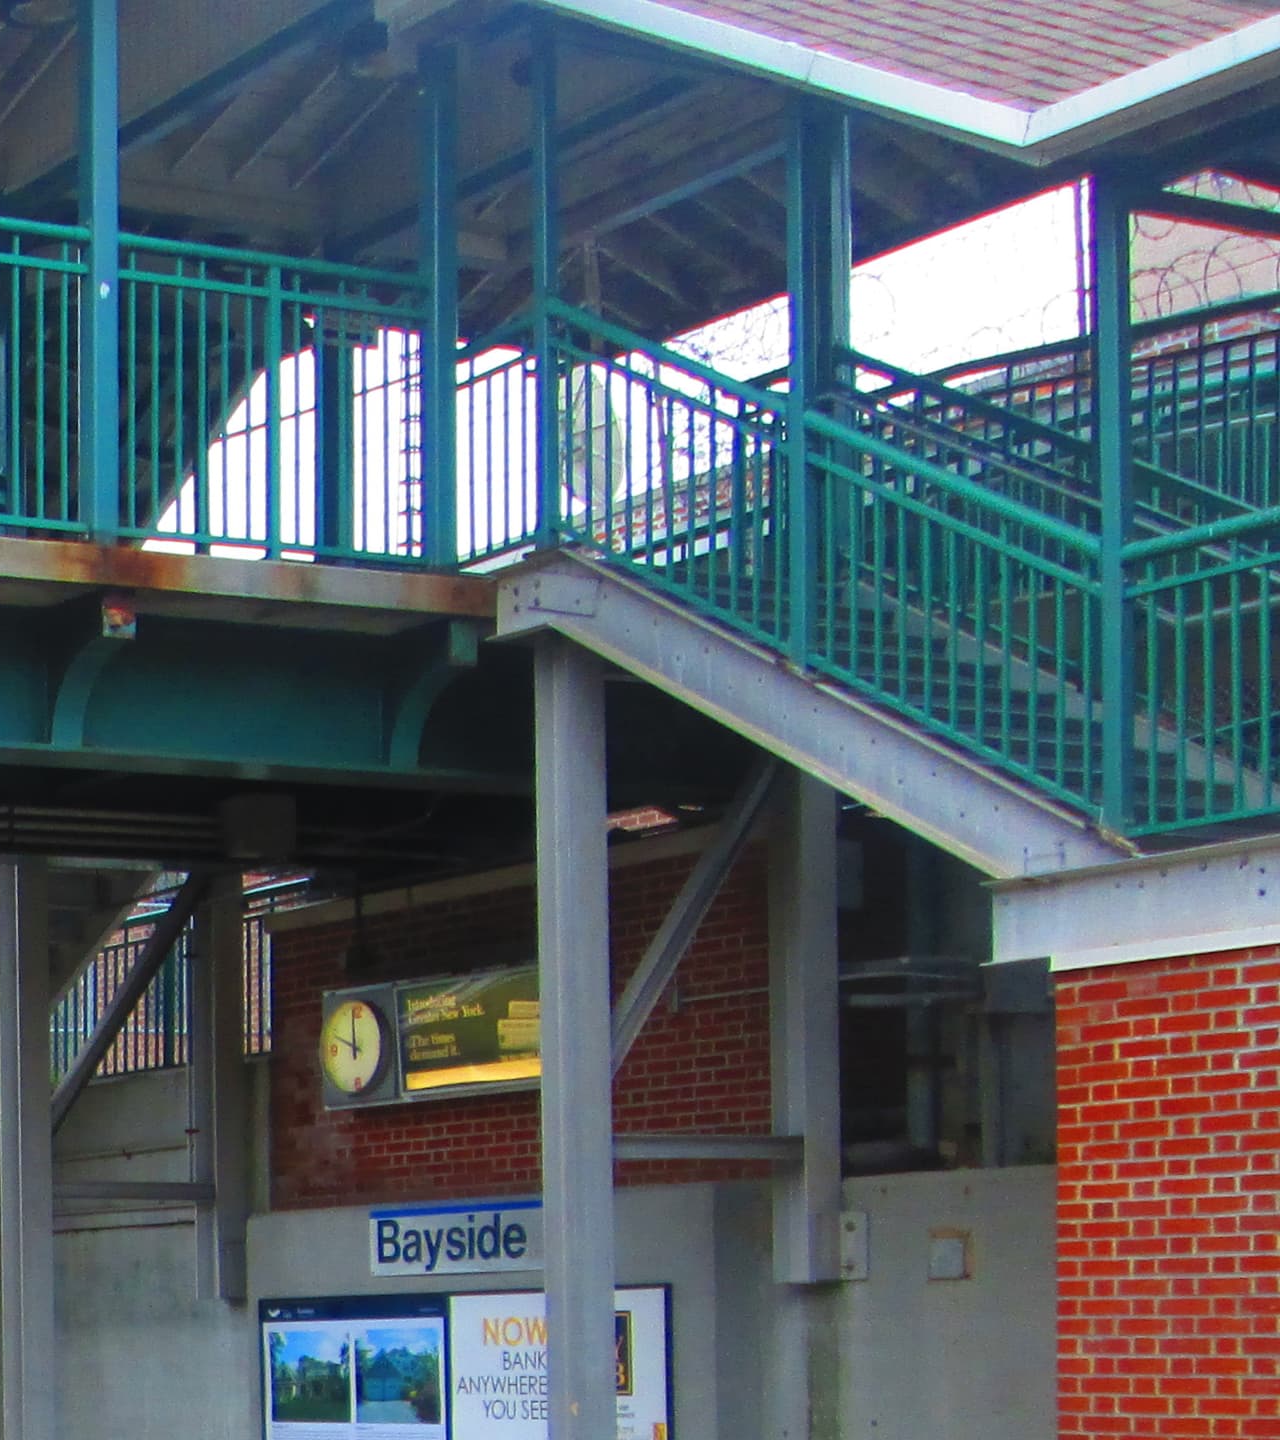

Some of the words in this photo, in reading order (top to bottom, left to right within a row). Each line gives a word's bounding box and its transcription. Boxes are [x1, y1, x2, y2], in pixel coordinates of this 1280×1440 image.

[377, 1213, 527, 1272] Bayside
[482, 1316, 549, 1347] NOW
[502, 1351, 547, 1371] BANK
[456, 1375, 549, 1396] ANYWHERE
[482, 1399, 517, 1420] YOU
[521, 1399, 549, 1421] SEE
